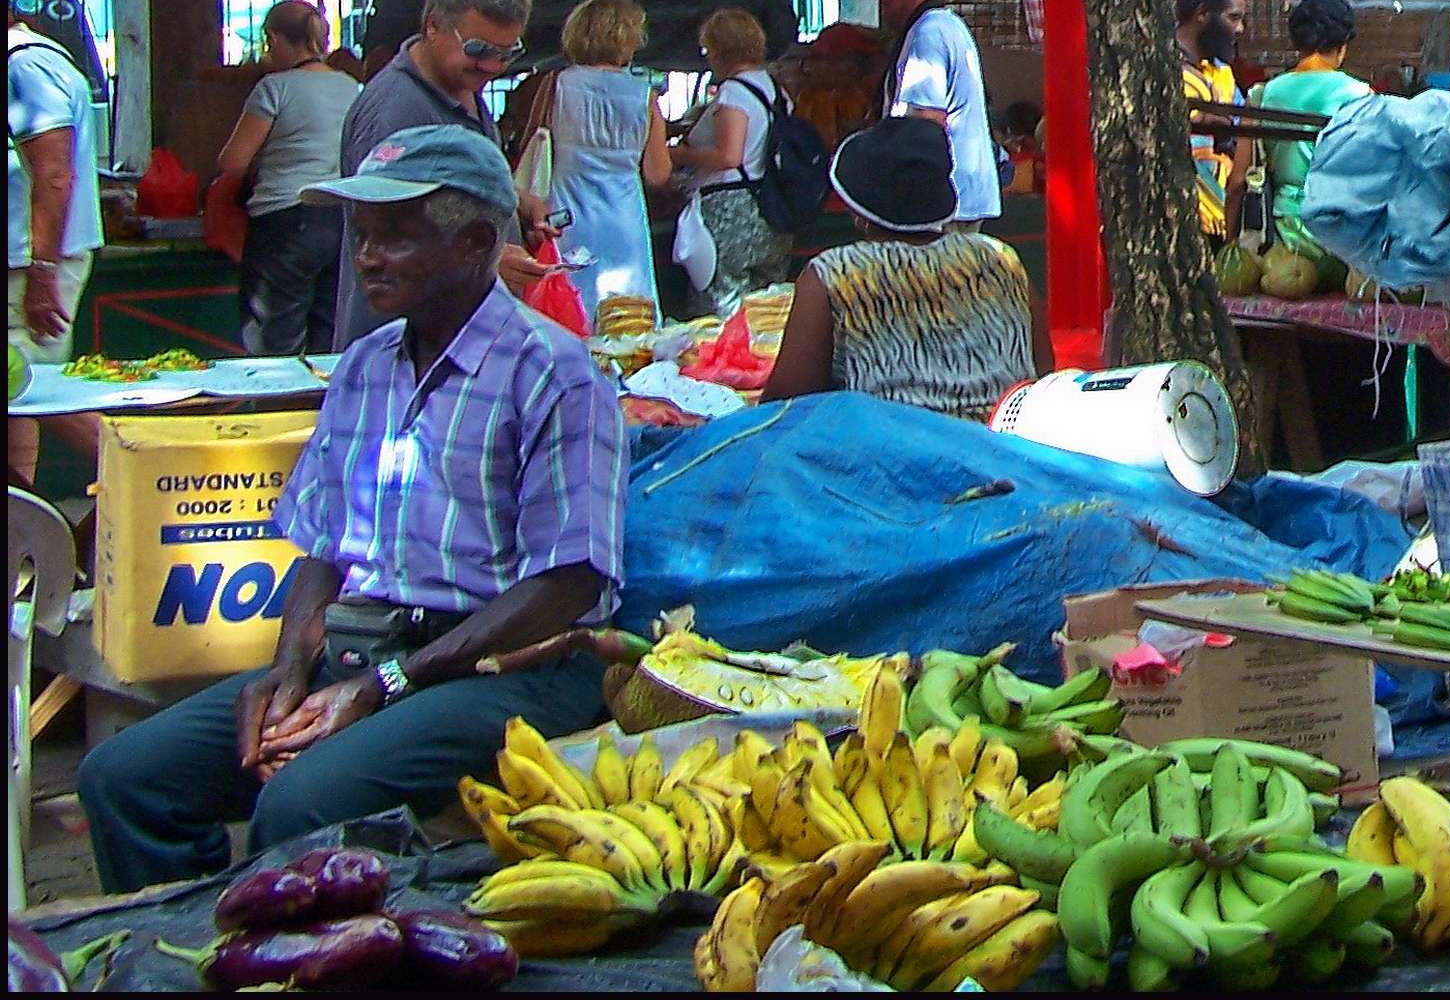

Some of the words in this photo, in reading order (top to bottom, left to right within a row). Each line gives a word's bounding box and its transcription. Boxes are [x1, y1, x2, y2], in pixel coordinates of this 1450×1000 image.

[156, 471, 283, 492] STANDARD
[176, 500, 232, 516] 2000
[179, 526, 267, 540] Tubes
